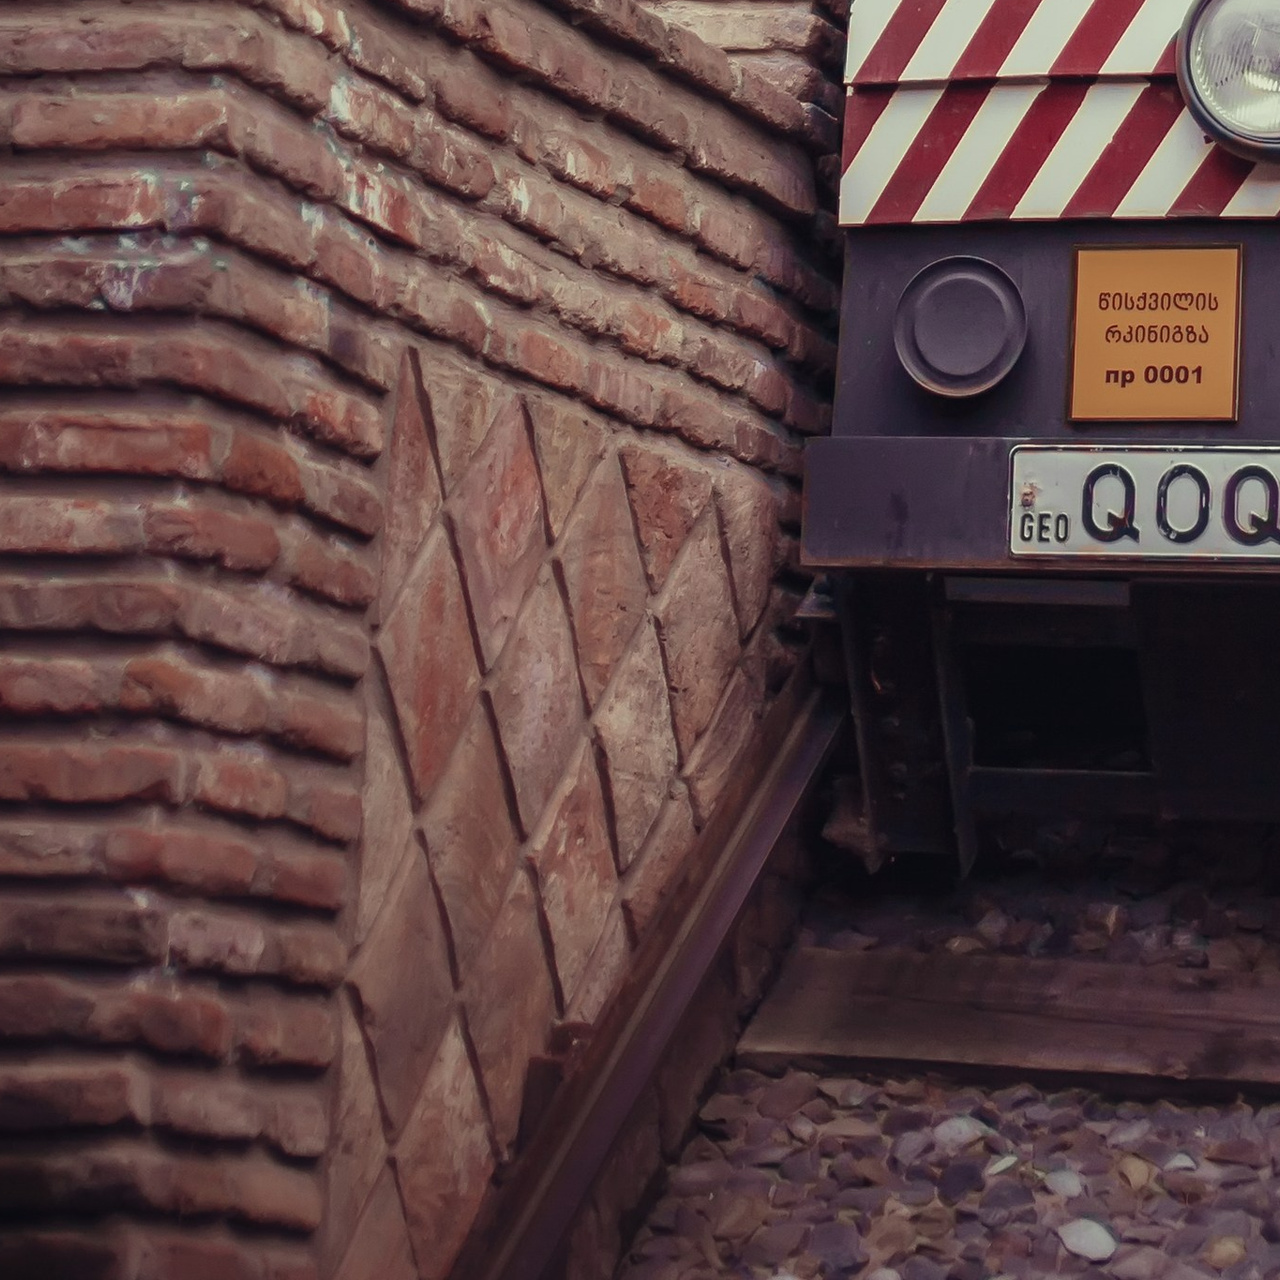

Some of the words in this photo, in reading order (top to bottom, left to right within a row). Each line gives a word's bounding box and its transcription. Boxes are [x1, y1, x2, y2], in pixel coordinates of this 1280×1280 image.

[1098, 291, 1219, 311] წისქვილის
[1105, 324, 1210, 343] რკინიგზა
[1143, 365, 1203, 384] 0001
[1020, 512, 1069, 543] GEO
